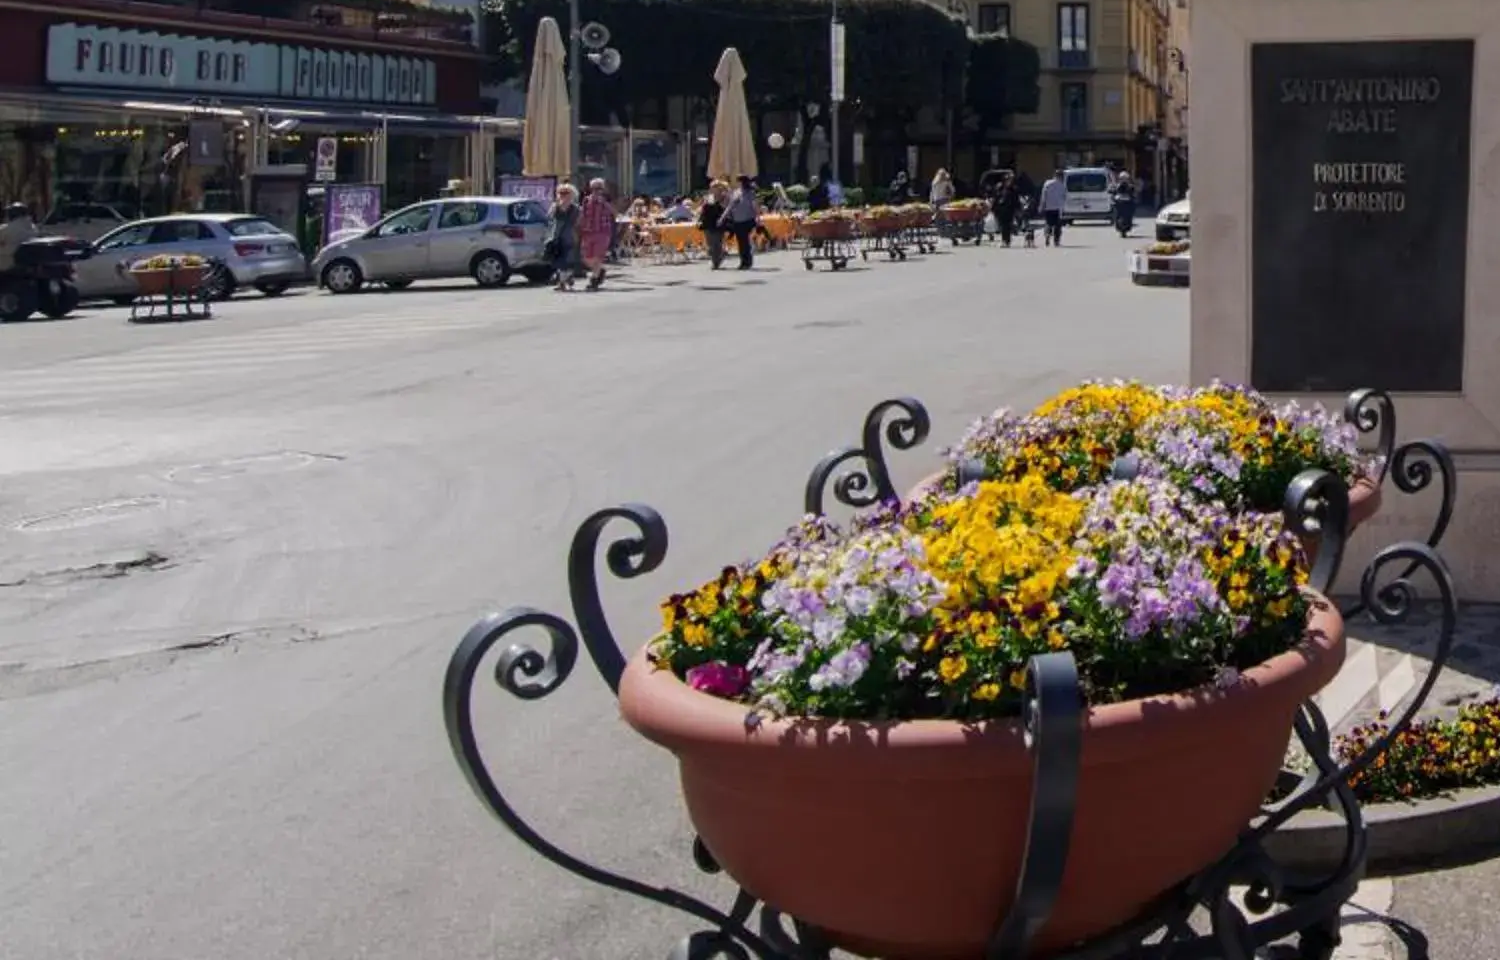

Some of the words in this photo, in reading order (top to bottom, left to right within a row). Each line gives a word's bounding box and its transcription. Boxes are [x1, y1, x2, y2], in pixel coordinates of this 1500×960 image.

[75, 38, 175, 78] FAUNO
[197, 49, 247, 83] BAR
[1327, 109, 1397, 133] ABATE
[1313, 163, 1406, 183] PROTETTORE
[1331, 192, 1406, 212] SORRENTO
